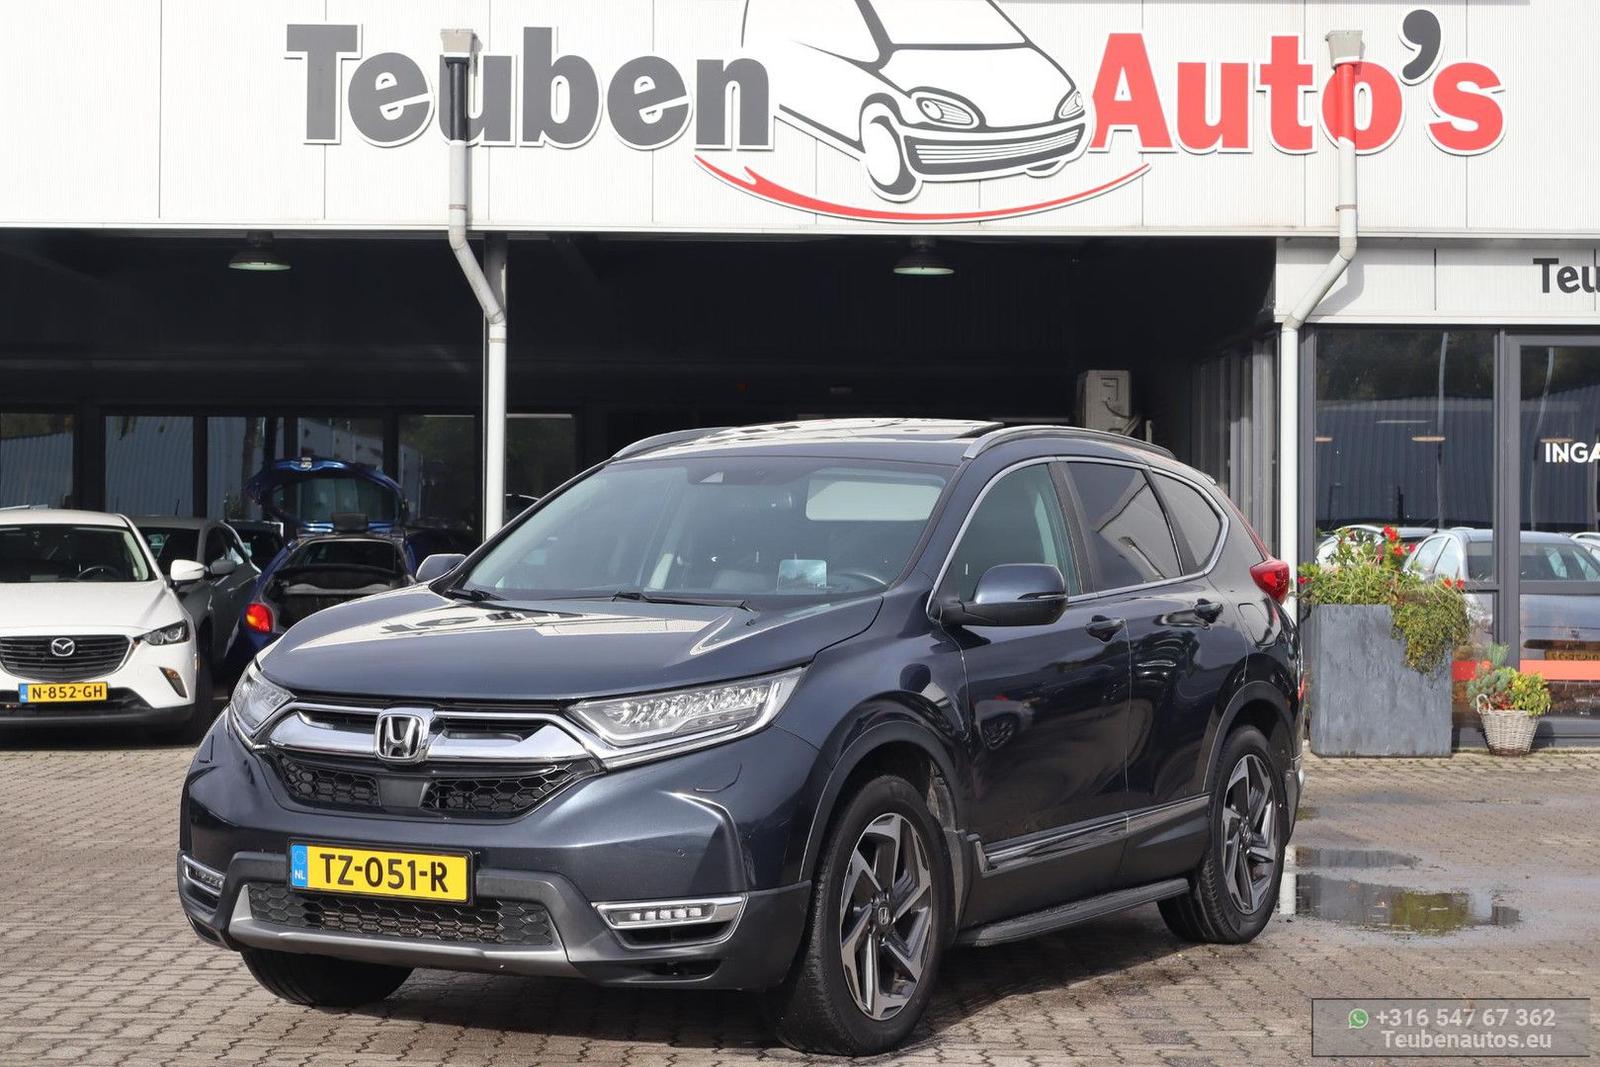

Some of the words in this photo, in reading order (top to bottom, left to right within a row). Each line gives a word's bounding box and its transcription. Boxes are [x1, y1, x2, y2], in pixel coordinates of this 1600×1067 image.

[286, 24, 772, 150] Teuben
[1088, 9, 1506, 156] Auto's
[1533, 258, 1600, 293] Teu
[32, 685, 103, 700] N-852-GH
[294, 870, 306, 881] NL
[319, 853, 449, 893] TZ-051-R
